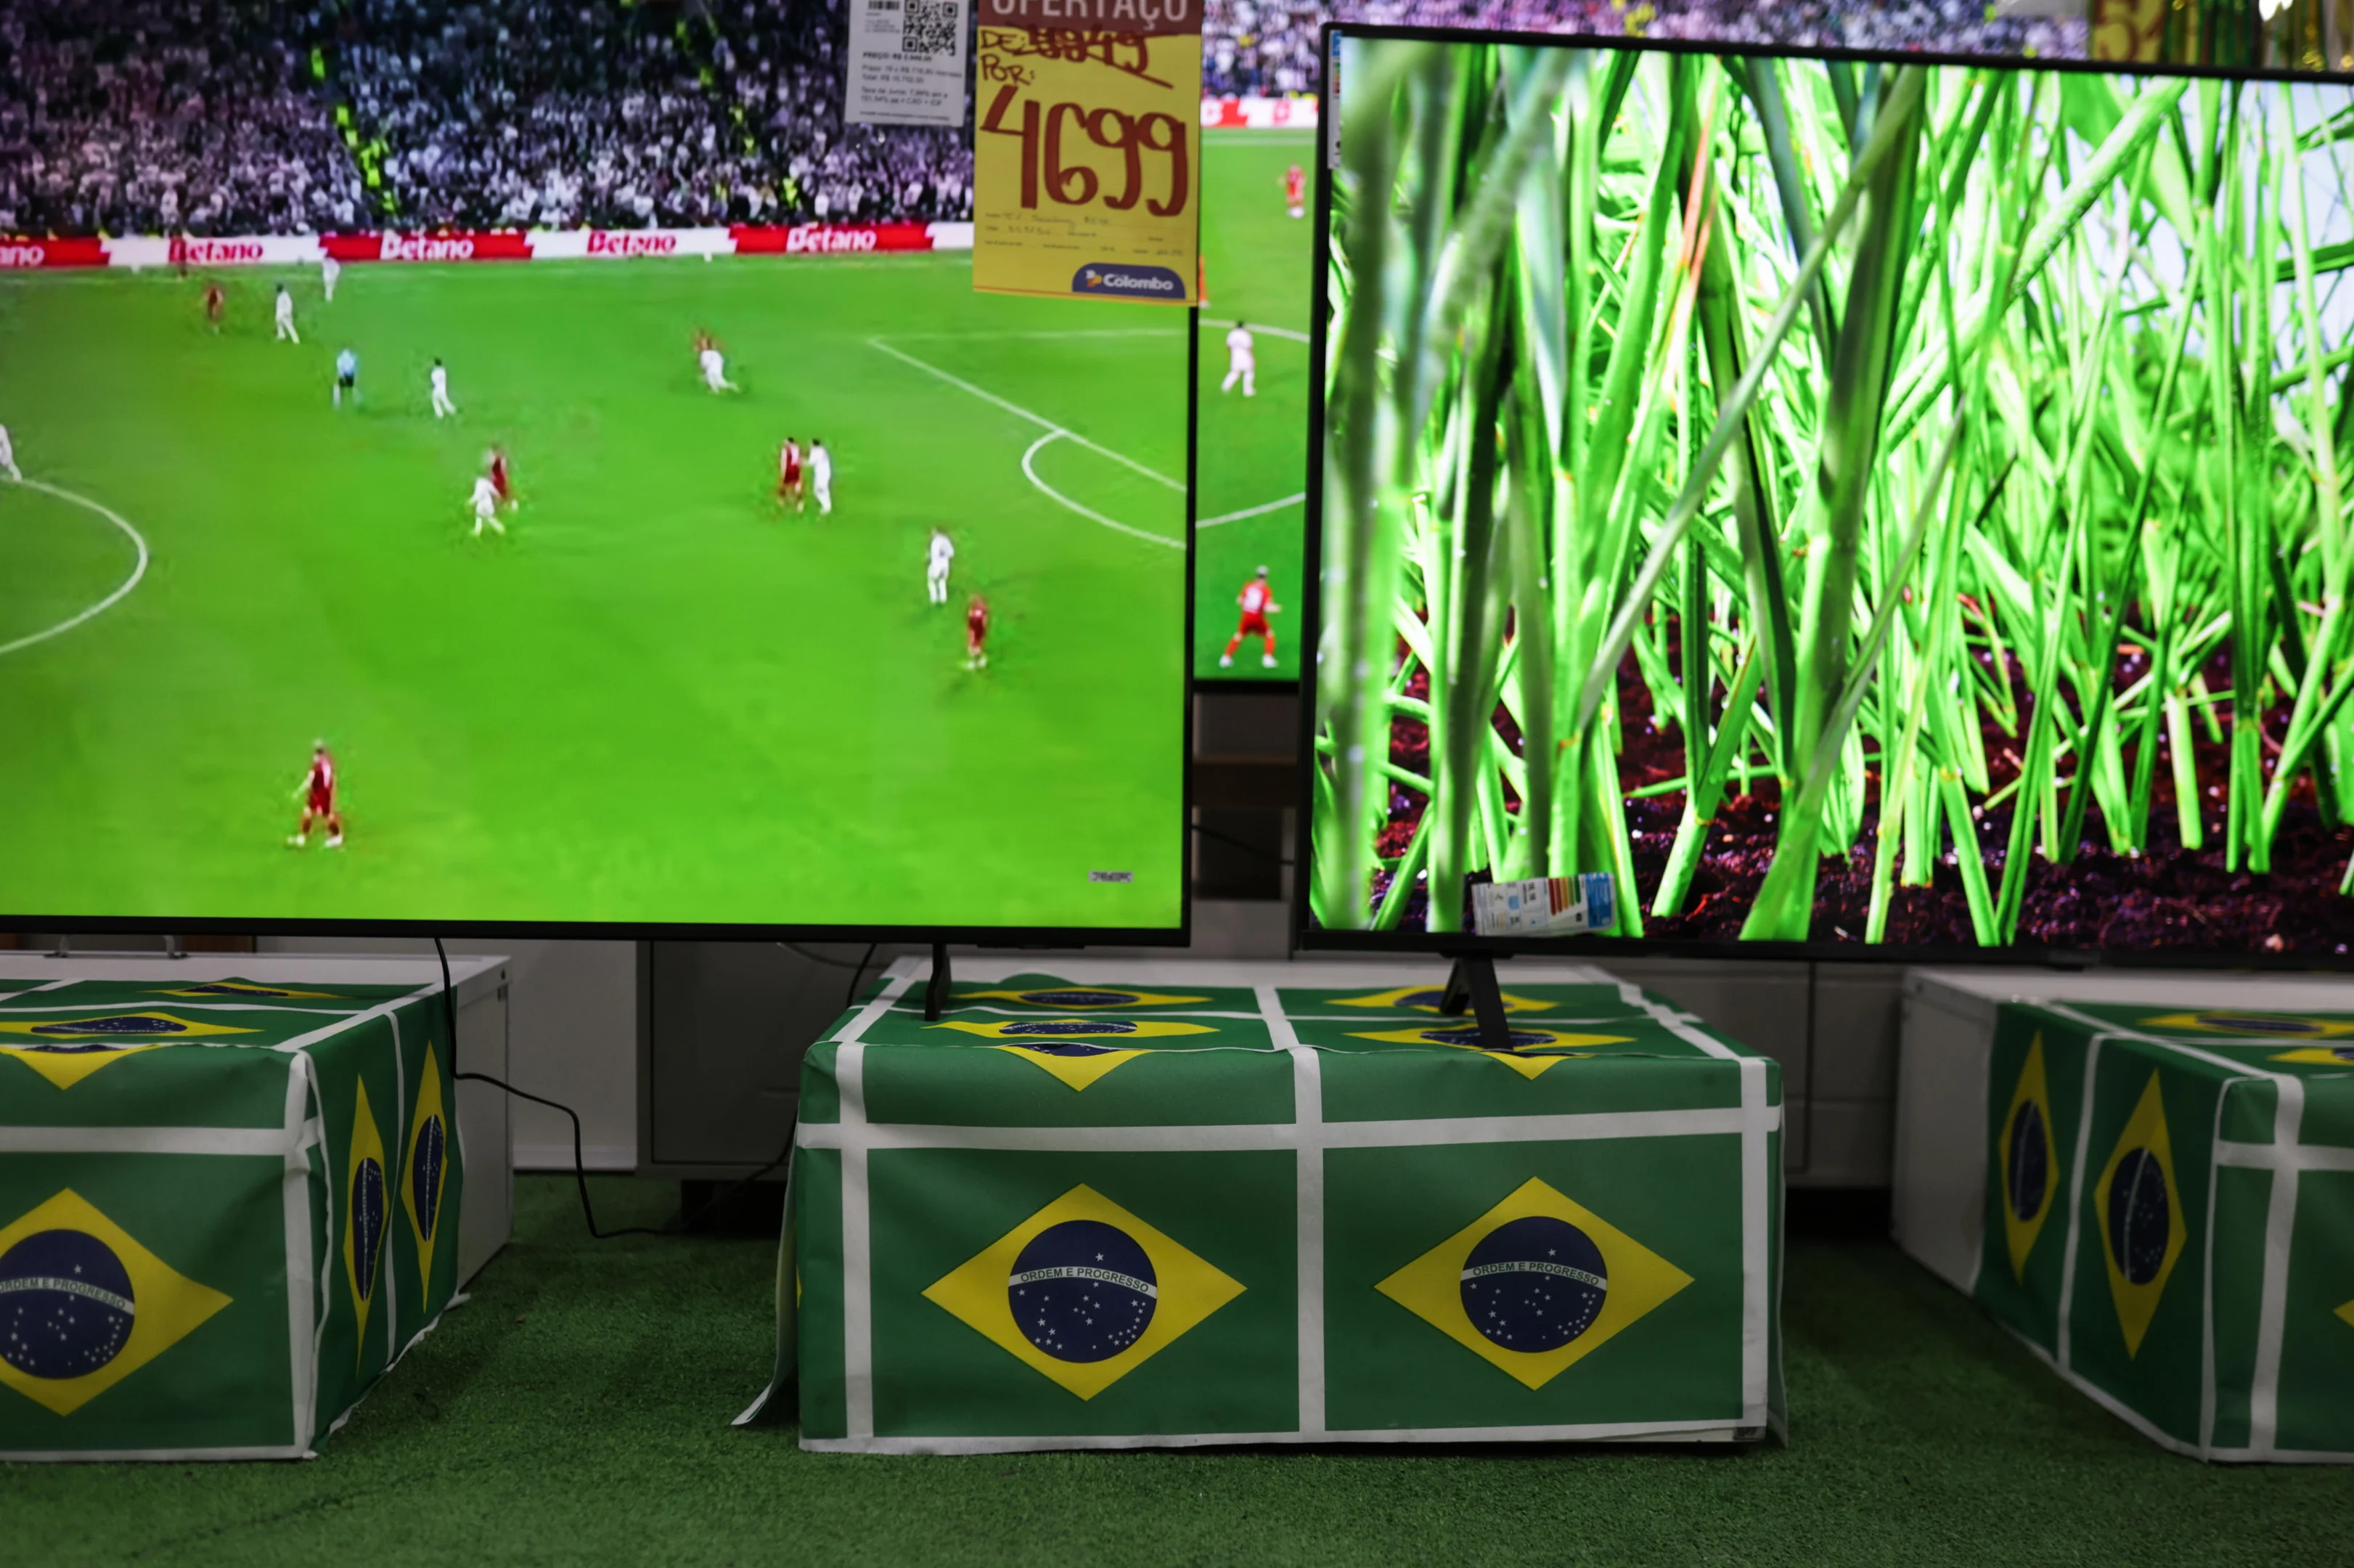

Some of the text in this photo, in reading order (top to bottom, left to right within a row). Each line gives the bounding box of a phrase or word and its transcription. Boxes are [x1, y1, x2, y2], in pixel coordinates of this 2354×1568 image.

[979, 54, 1036, 86] POR:
[979, 84, 1188, 217] 4699
[380, 230, 475, 260] Betano
[587, 229, 677, 256] Betano
[786, 224, 878, 253] Betano
[1103, 273, 1174, 291] Colombo
[1020, 1267, 1149, 1293] ORDEM E PROGRESSO
[1472, 1262, 1599, 1286] ORDEM E PROGRESSO
[53, 1279, 126, 1310] PROGRESSO
